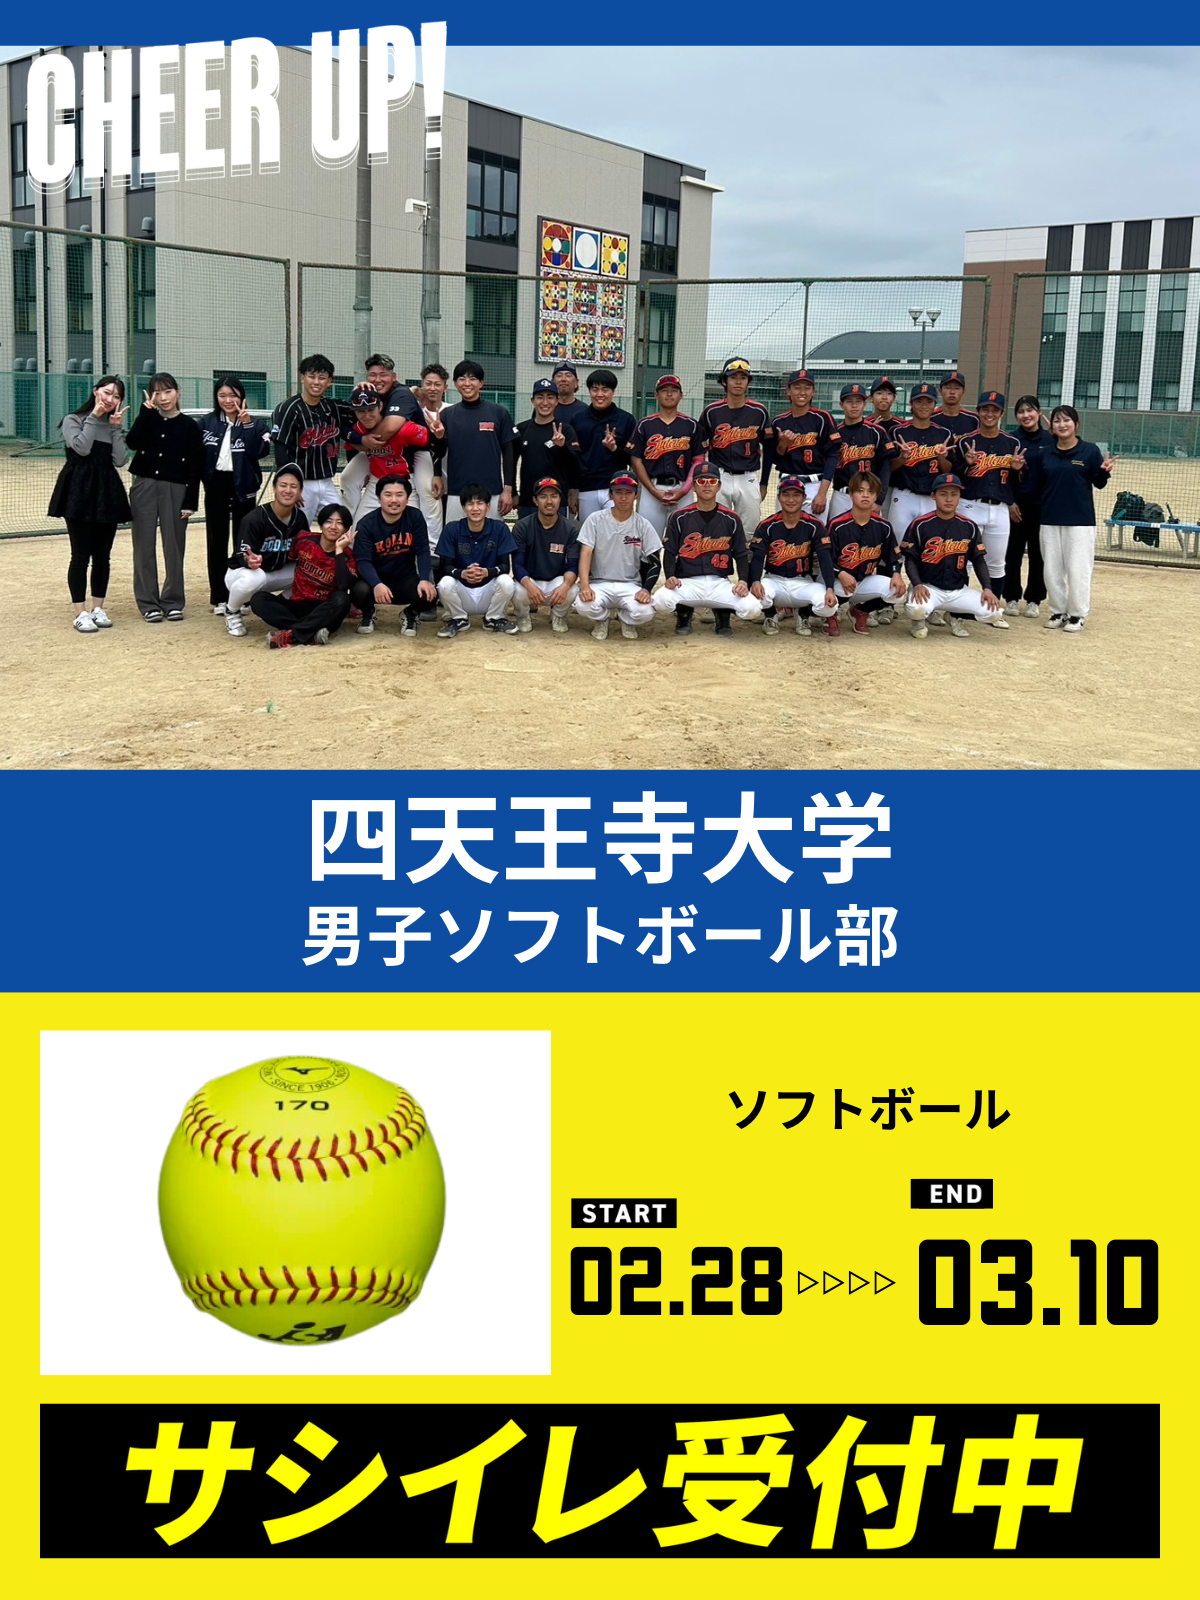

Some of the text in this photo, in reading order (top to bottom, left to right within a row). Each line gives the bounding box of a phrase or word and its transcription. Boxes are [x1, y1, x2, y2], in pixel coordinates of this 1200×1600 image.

[676, 454, 685, 469] 4
[804, 449, 813, 463] 8
[929, 460, 939, 474] 2
[1000, 470, 1009, 484] 7
[711, 553, 729, 569] 42
[271, 1078, 336, 1092] SINCE 1906
[274, 1100, 330, 1111] 170
